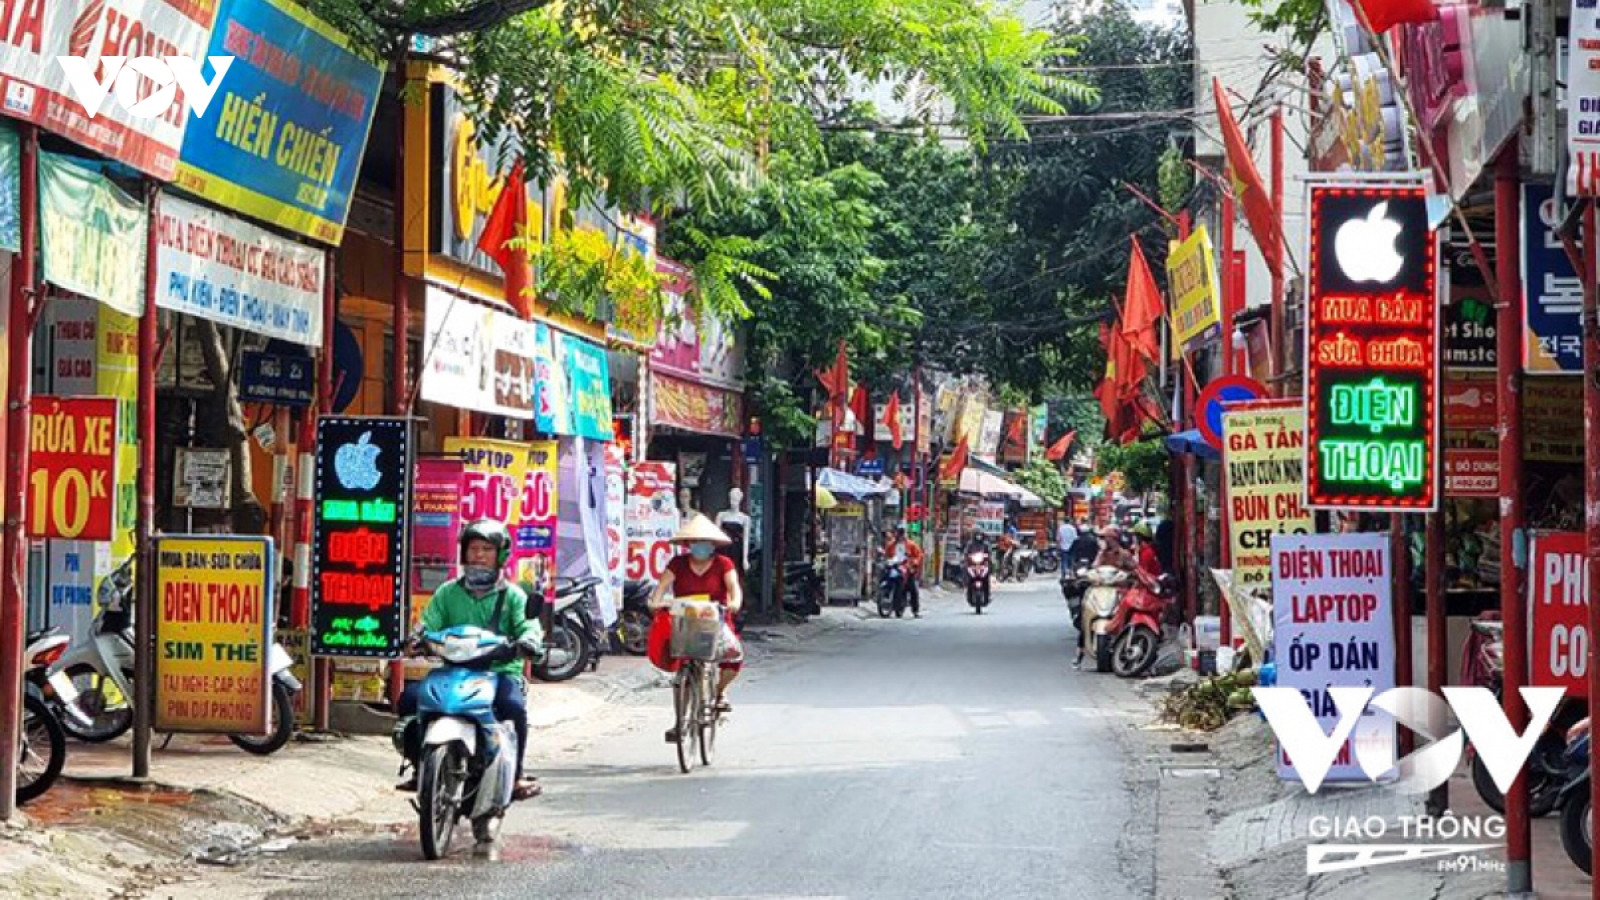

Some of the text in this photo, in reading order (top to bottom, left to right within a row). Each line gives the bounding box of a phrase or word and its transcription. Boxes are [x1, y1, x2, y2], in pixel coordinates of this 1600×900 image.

[1322, 291, 1423, 323] MUA BÁN
[1457, 322, 1496, 338] Sho
[1318, 332, 1362, 363] SỬA
[1330, 377, 1414, 433] ĐIỆN
[31, 403, 77, 453] RỬA
[84, 415, 112, 456] XE
[1229, 429, 1257, 451] GÀ
[1318, 439, 1426, 490] THOẠI
[1233, 489, 1270, 521] BÚN
[329, 527, 388, 568] ĐIỆN
[1239, 521, 1308, 549] CH
[161, 551, 183, 568] MUA
[235, 548, 262, 569] CHỮA
[1279, 544, 1383, 585] ĐIỆN THOẠI
[164, 574, 259, 632] ĐIỆN THOẠI
[321, 572, 393, 611] THOẠI
[1291, 593, 1377, 624] LAPTOP
[163, 638, 258, 663] SIM THẺ
[1288, 632, 1379, 672] ỐP DÁN
[167, 700, 189, 717] PIN
